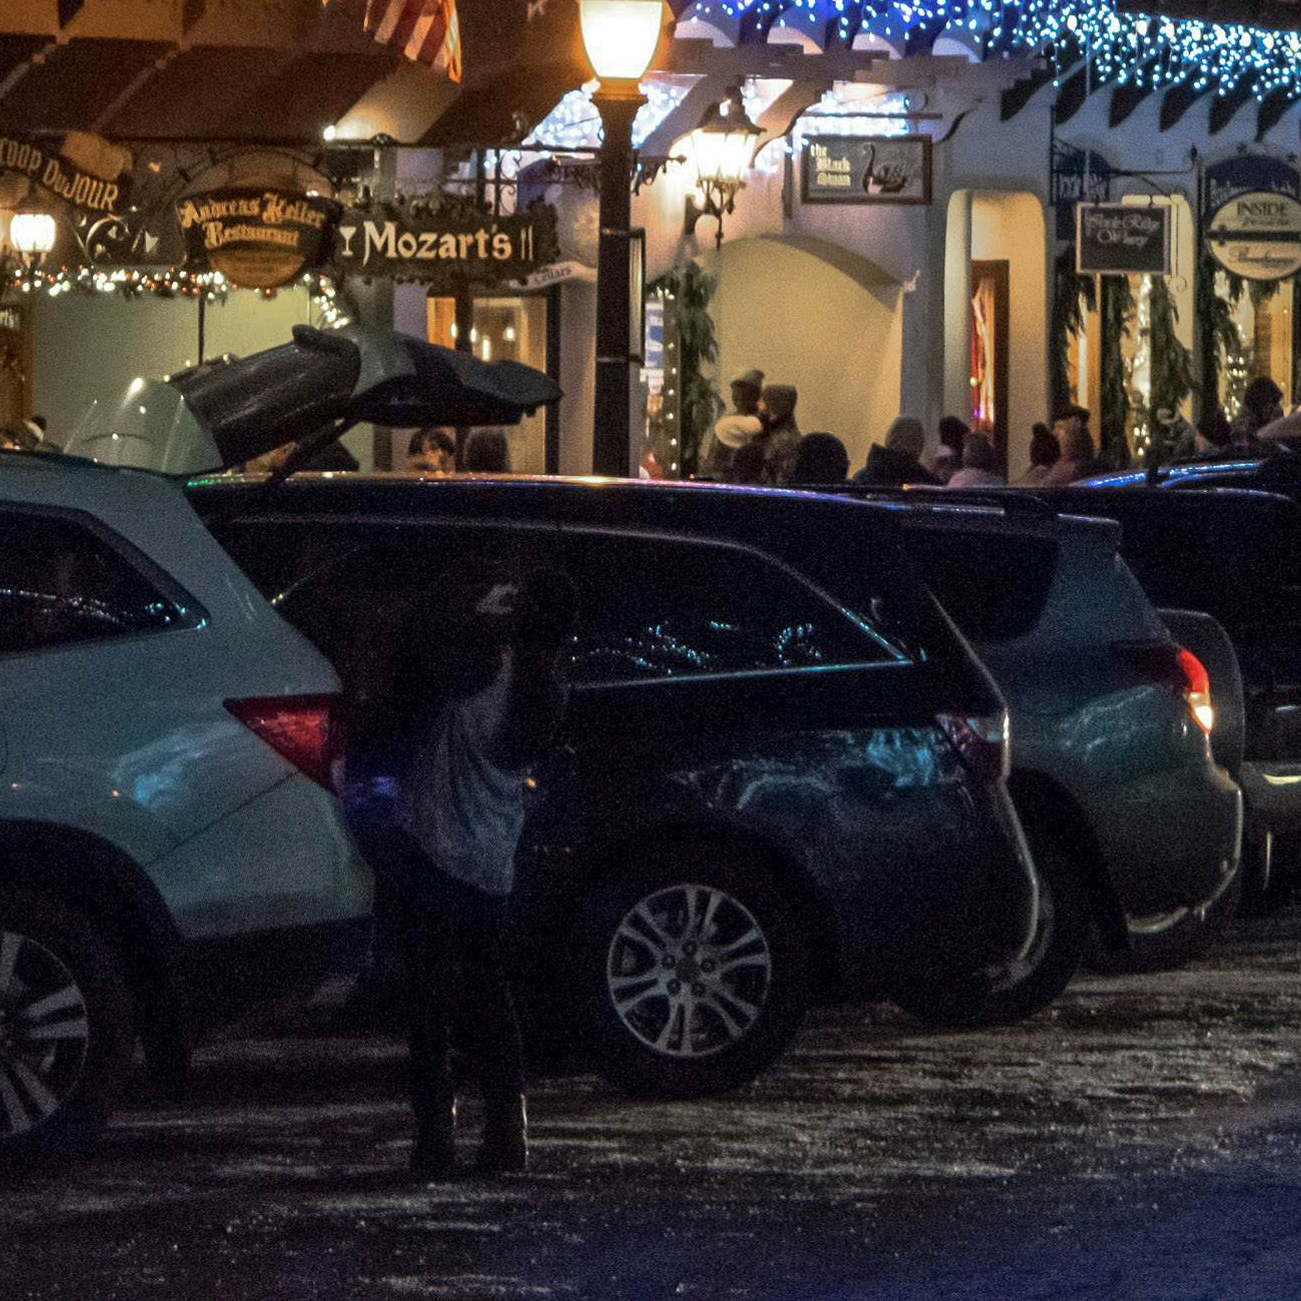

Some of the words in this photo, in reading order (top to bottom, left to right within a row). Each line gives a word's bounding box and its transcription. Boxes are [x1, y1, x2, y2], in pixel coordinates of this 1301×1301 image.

[180, 198, 260, 228] Andreas
[262, 193, 325, 228] Keller
[202, 221, 299, 249] Restaurant
[362, 221, 512, 266] Mozart's
